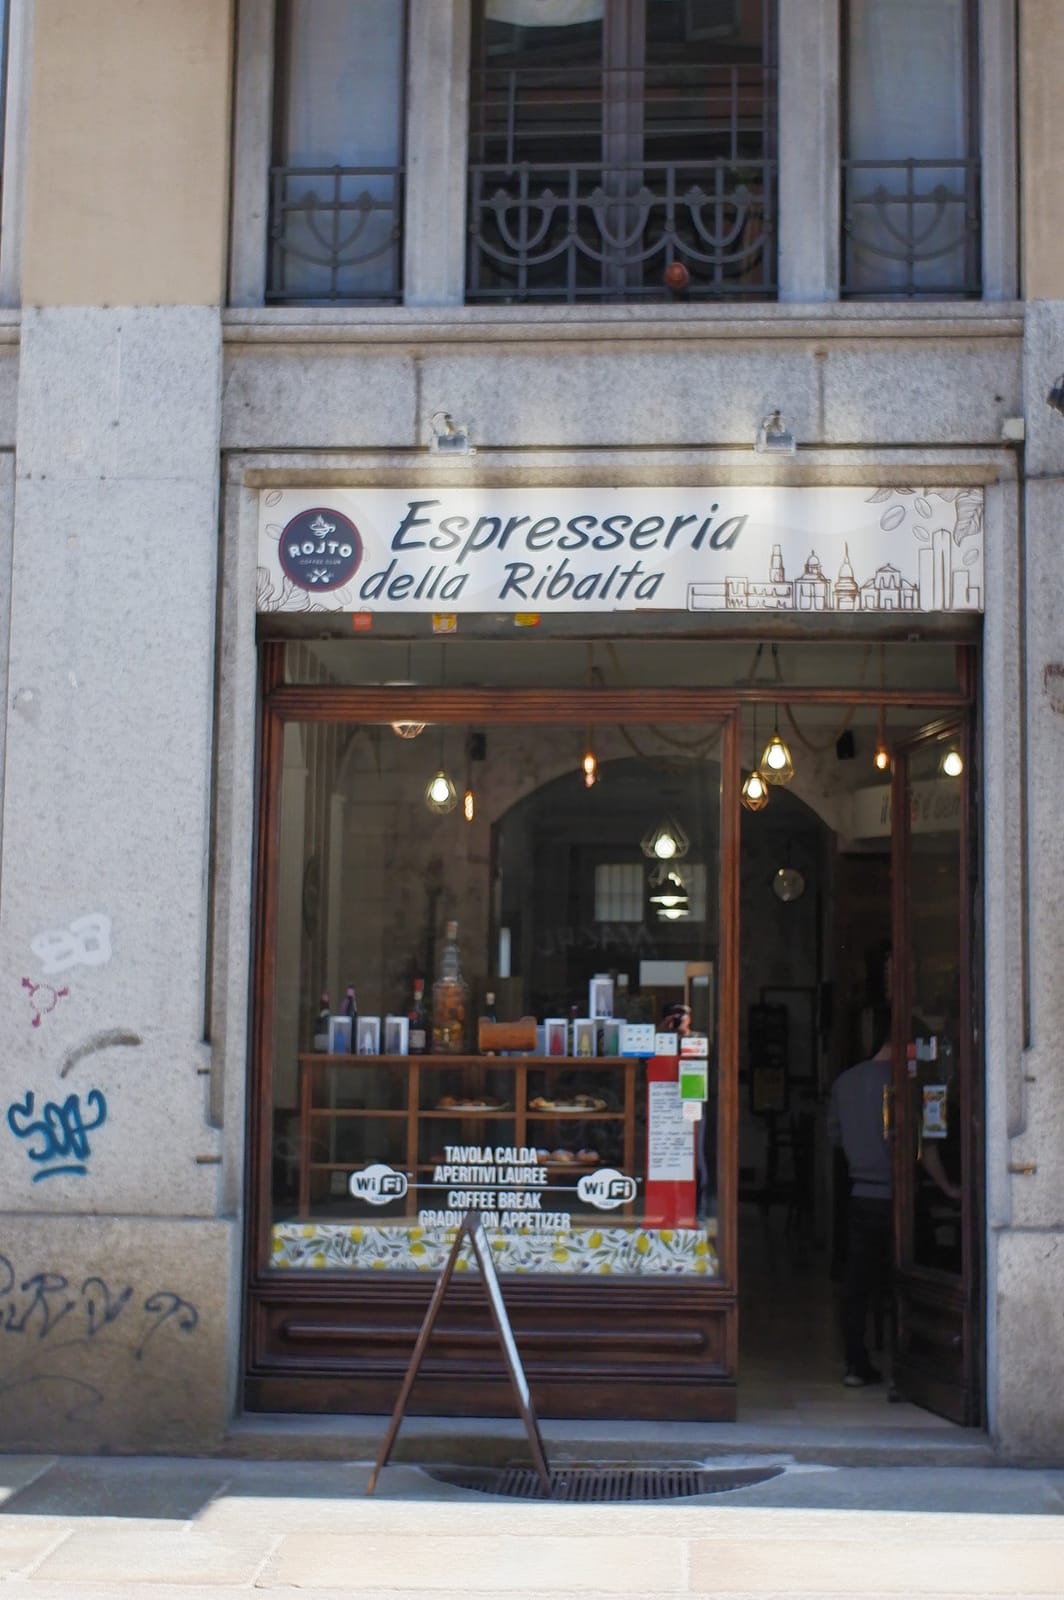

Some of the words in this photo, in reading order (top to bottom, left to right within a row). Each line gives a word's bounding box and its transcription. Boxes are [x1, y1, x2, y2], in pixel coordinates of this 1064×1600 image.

[391, 499, 748, 564] Espresseria
[289, 541, 352, 558] ROJTO
[359, 558, 470, 601] della
[499, 558, 665, 601] Ribalta
[445, 1146, 493, 1164] TAVOLA
[495, 1147, 538, 1165] CALDA
[433, 1166, 496, 1184] APERITIVI
[498, 1167, 548, 1185] LAUREE
[448, 1191, 496, 1208] COFFEE
[498, 1192, 542, 1209] BREAK
[418, 1210, 500, 1227] GRADUON
[501, 1211, 571, 1229] APPETIZER
